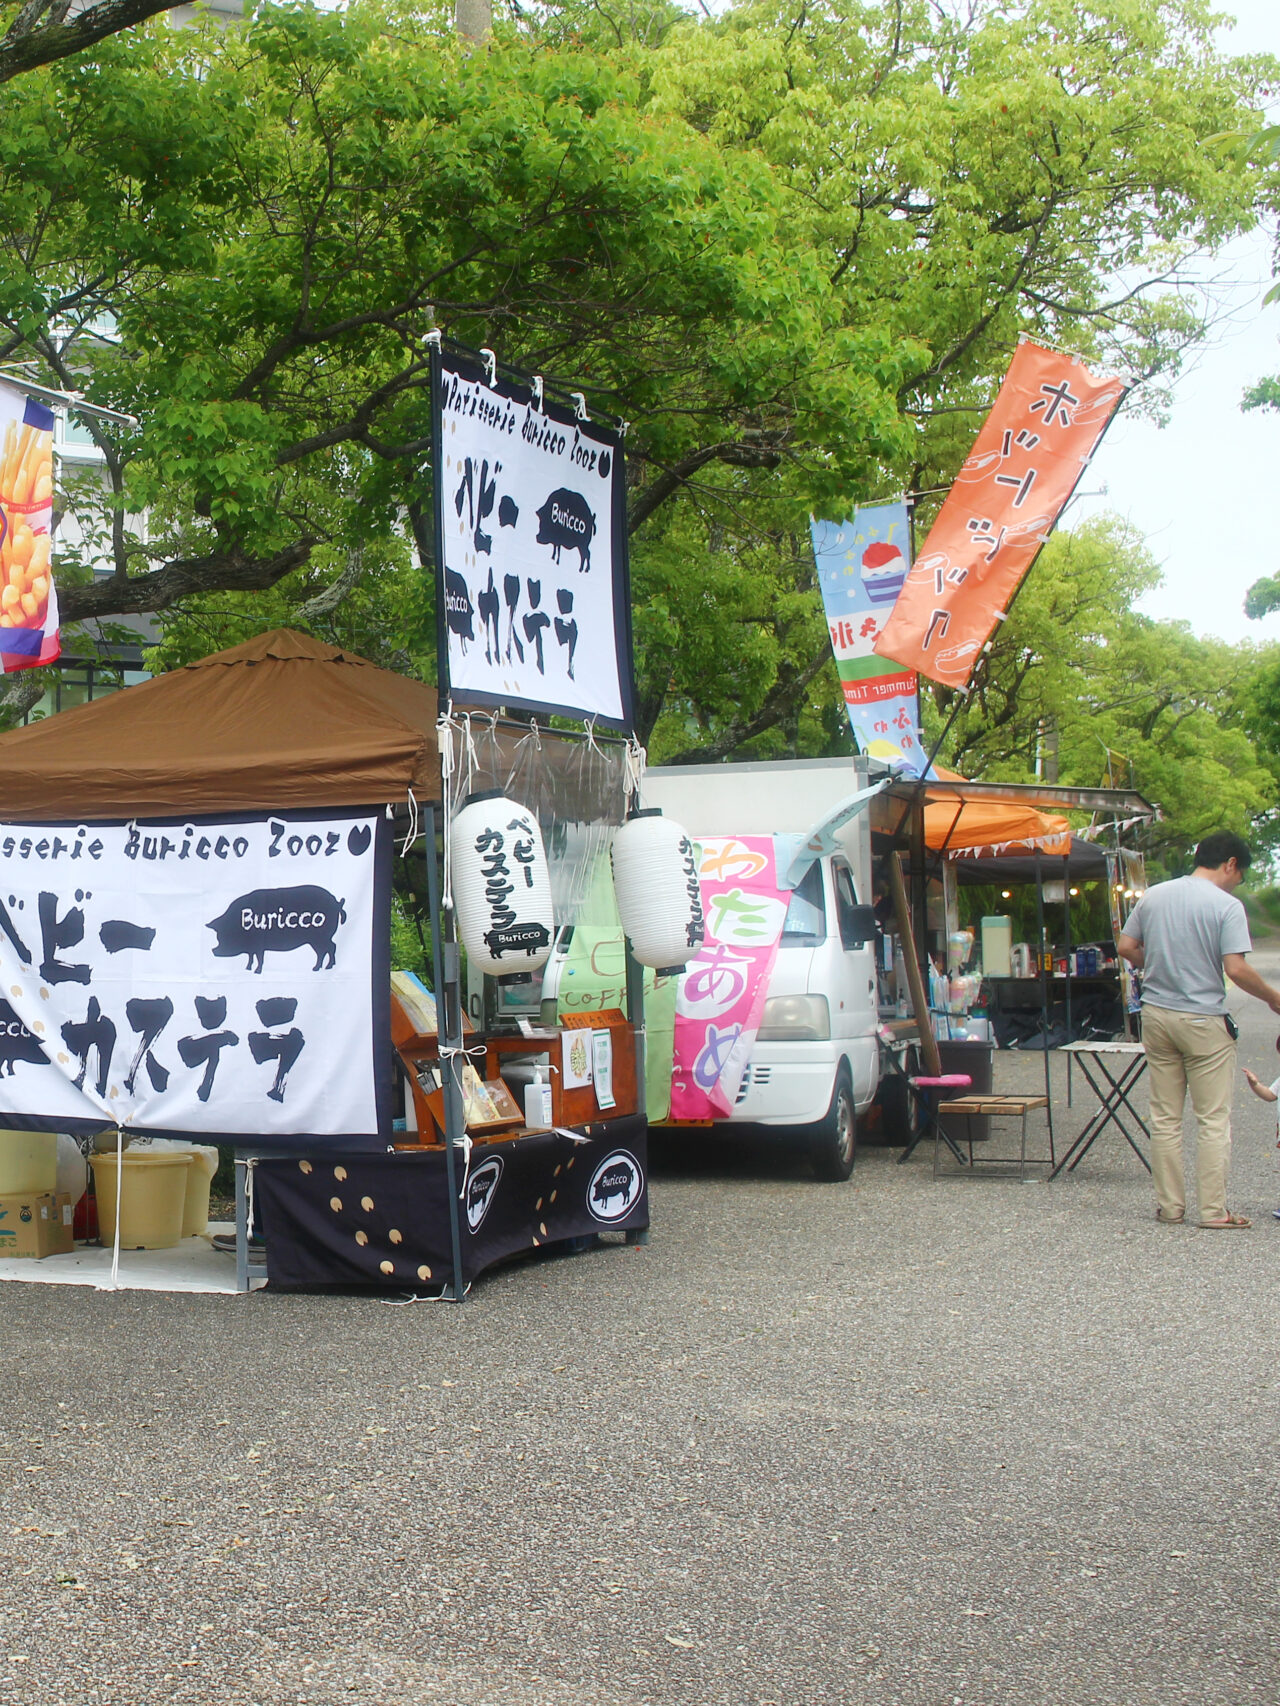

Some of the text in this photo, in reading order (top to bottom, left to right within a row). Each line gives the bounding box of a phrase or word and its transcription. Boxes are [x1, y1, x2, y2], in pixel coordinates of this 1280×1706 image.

[448, 376, 516, 435] Patisserie
[522, 405, 566, 455] Buricco
[455, 456, 520, 556] ベビー
[551, 502, 587, 535] Buricco
[478, 566, 579, 682] カステラ
[124, 822, 249, 861] Buricco
[506, 816, 535, 888] ベビー
[475, 827, 517, 930] カステラ
[240, 907, 327, 931] Buricco
[498, 930, 541, 944] Buricco
[565, 974, 669, 1011] COFFE
[60, 995, 306, 1104] カステラ
[601, 1173, 628, 1189] Buricco
